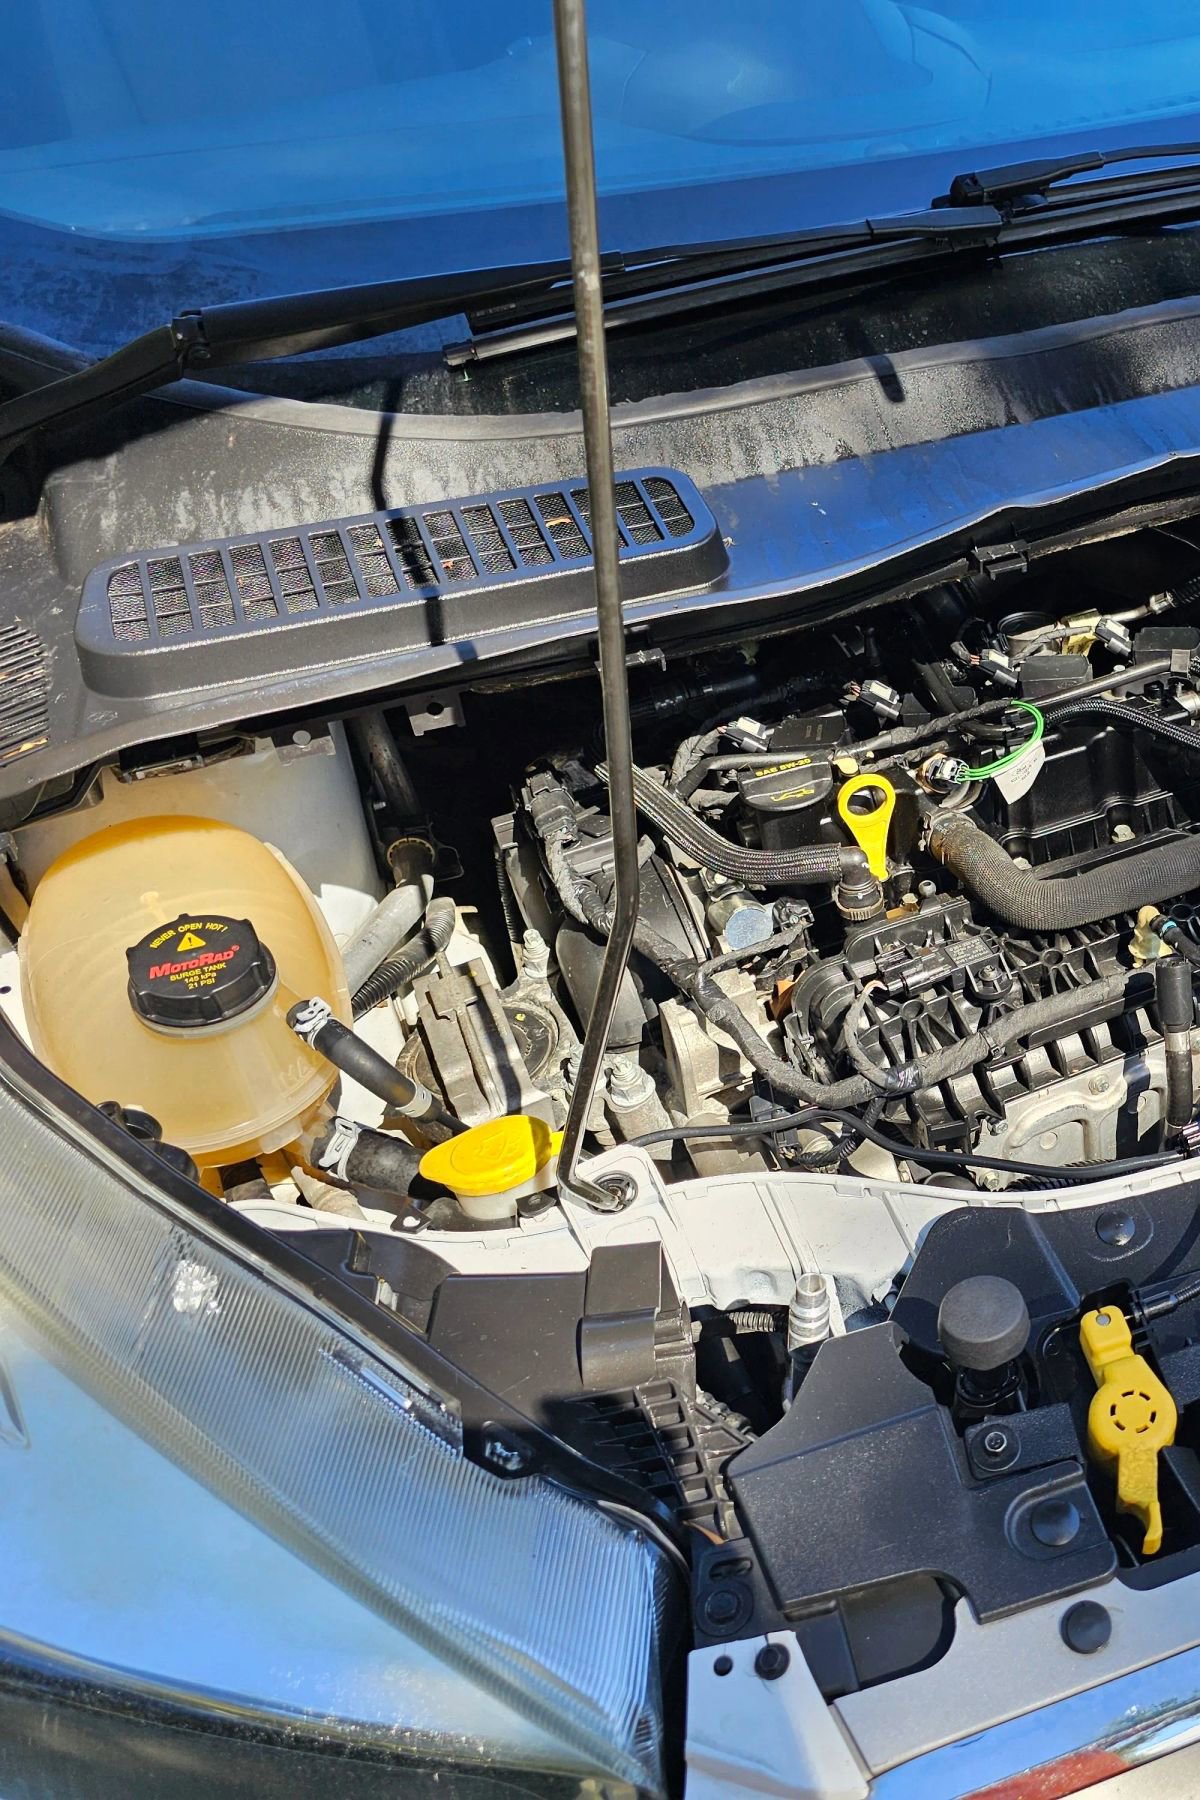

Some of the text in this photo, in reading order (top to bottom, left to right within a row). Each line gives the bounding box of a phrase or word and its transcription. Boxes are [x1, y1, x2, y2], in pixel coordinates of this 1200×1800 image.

[755, 758, 811, 777] SAE 5W-20
[150, 930, 176, 949] NEVER
[178, 922, 202, 933] OPEN
[170, 962, 227, 981] SURGE TANK
[185, 972, 217, 984] 145 kPa
[188, 978, 216, 990] 21 PSI
